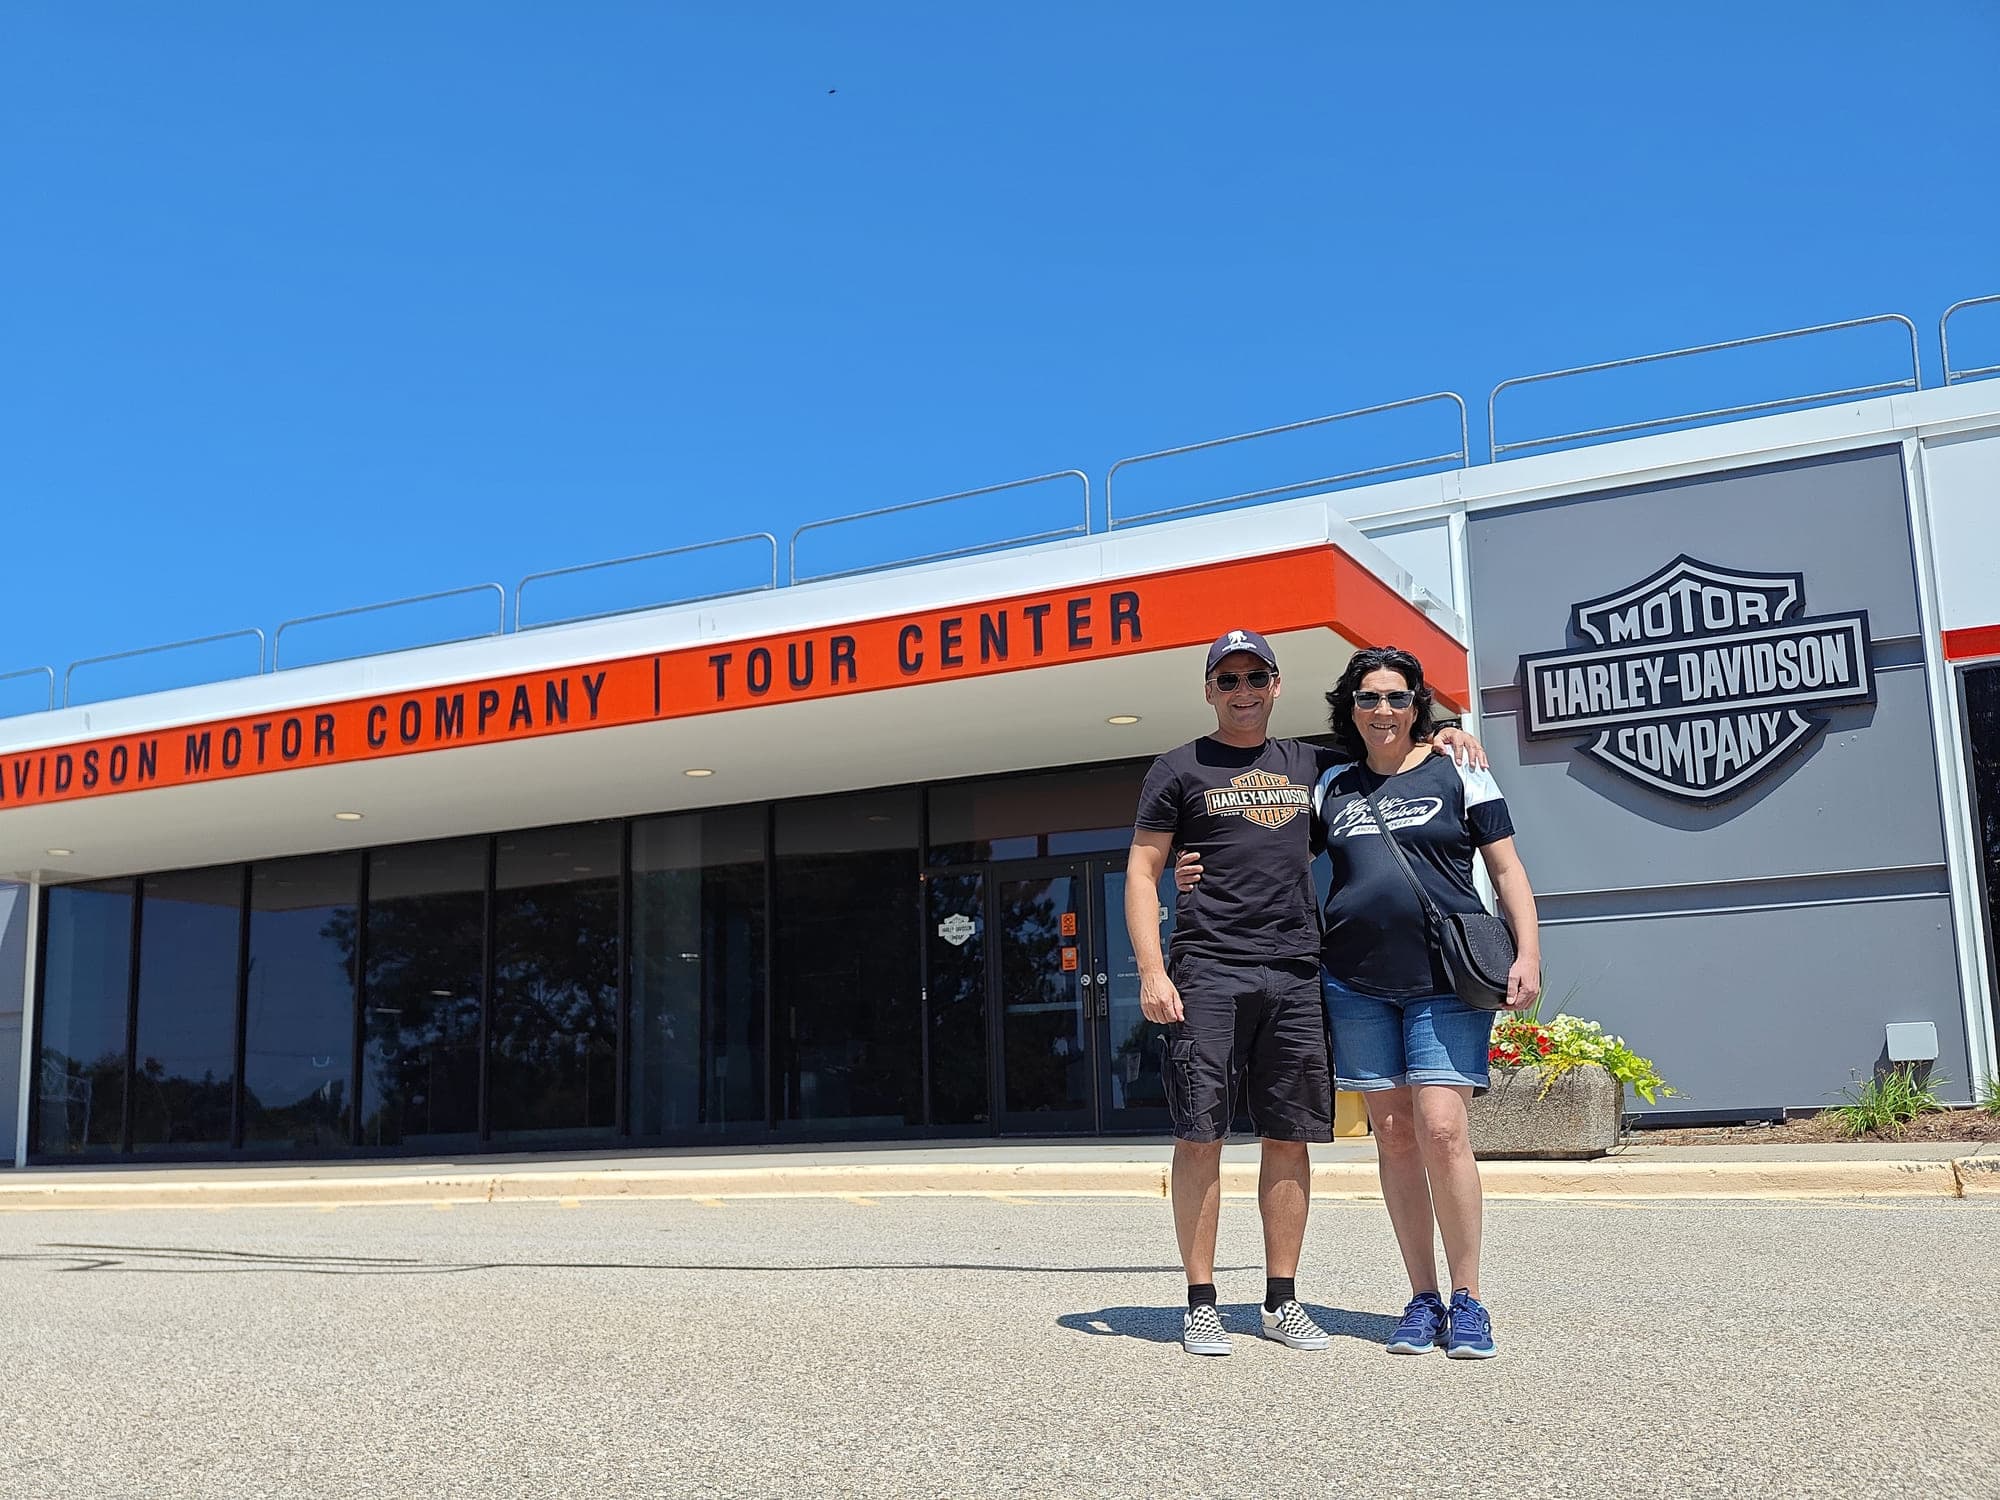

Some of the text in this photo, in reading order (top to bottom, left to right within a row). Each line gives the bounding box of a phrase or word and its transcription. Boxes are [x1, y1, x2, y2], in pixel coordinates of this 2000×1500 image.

[1609, 578, 1770, 643] MOTOR
[185, 713, 335, 774] MOTOR
[367, 672, 606, 748] COMPANY
[709, 635, 857, 700] TOUR
[898, 591, 1142, 675] CENTER
[1542, 633, 1850, 719] HARLEY-DAVIDSON
[1617, 709, 1782, 785] COMPANY
[1211, 789, 1310, 810] HARLEY-DAVIDSON
[1239, 773, 1281, 787] MOTOR
[1248, 807, 1292, 825] CYCLES
